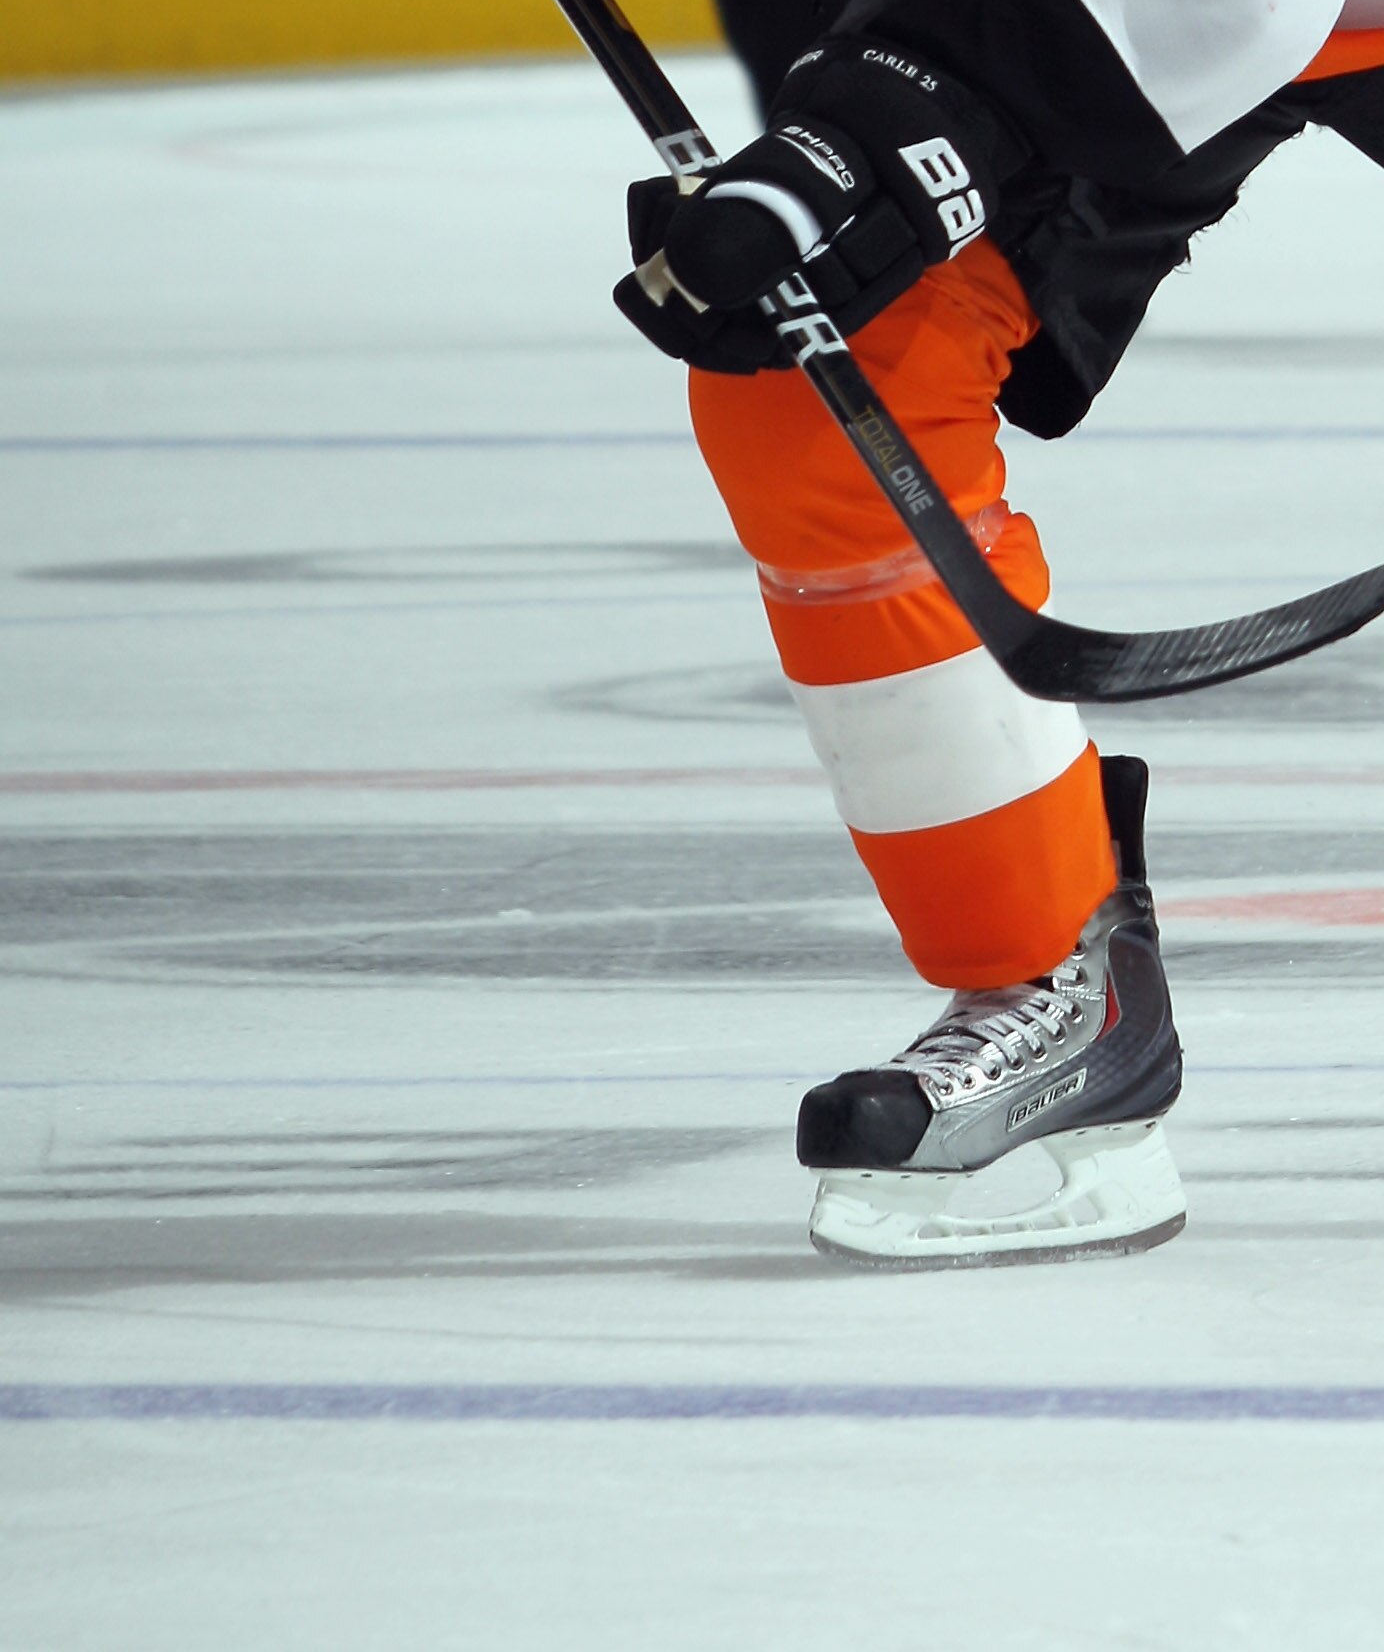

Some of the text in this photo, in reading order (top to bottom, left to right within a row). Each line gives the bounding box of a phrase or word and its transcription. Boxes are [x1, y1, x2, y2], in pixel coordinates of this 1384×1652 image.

[919, 75, 938, 92] 25
[898, 136, 986, 261] BA
[1011, 1074, 1084, 1126] BAUER
